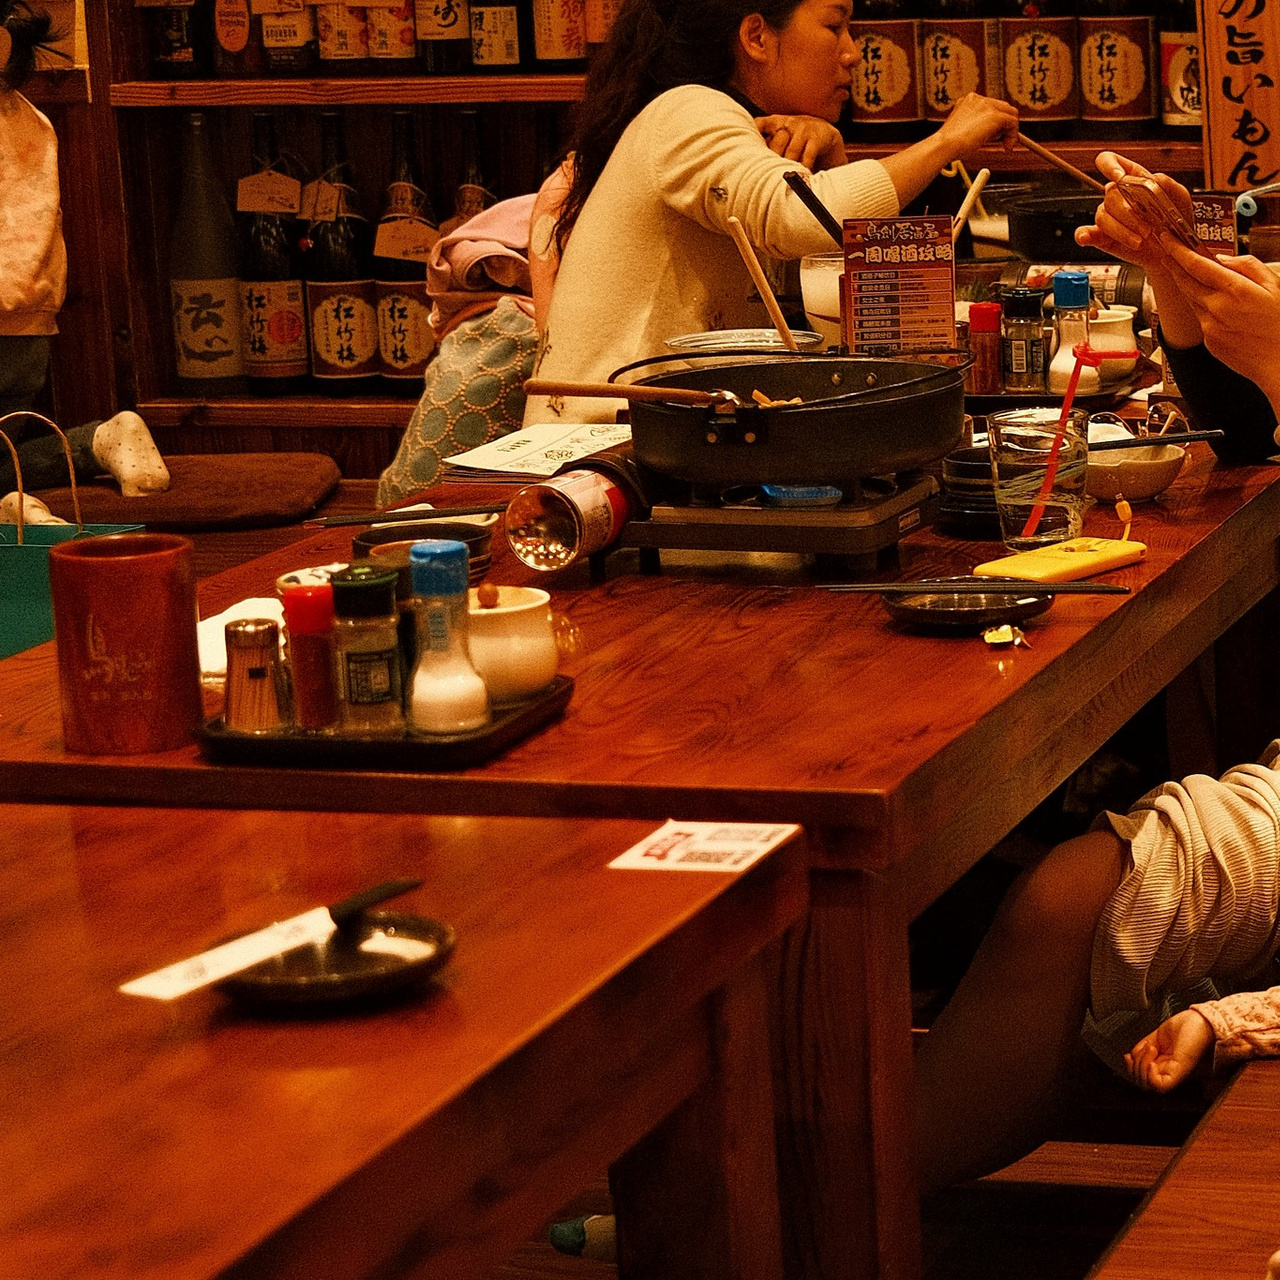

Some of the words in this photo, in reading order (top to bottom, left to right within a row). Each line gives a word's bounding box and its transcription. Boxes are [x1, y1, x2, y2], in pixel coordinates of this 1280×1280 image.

[861, 38, 884, 106] 松竹梅
[931, 38, 952, 106] 松竹梅
[1027, 38, 1051, 107] 松竹梅
[1095, 37, 1119, 106] 松竹梅
[848, 243, 953, 264] 一周喝酒攻略
[332, 300, 358, 362] 松竹梅
[388, 299, 409, 362] 松竹梅
